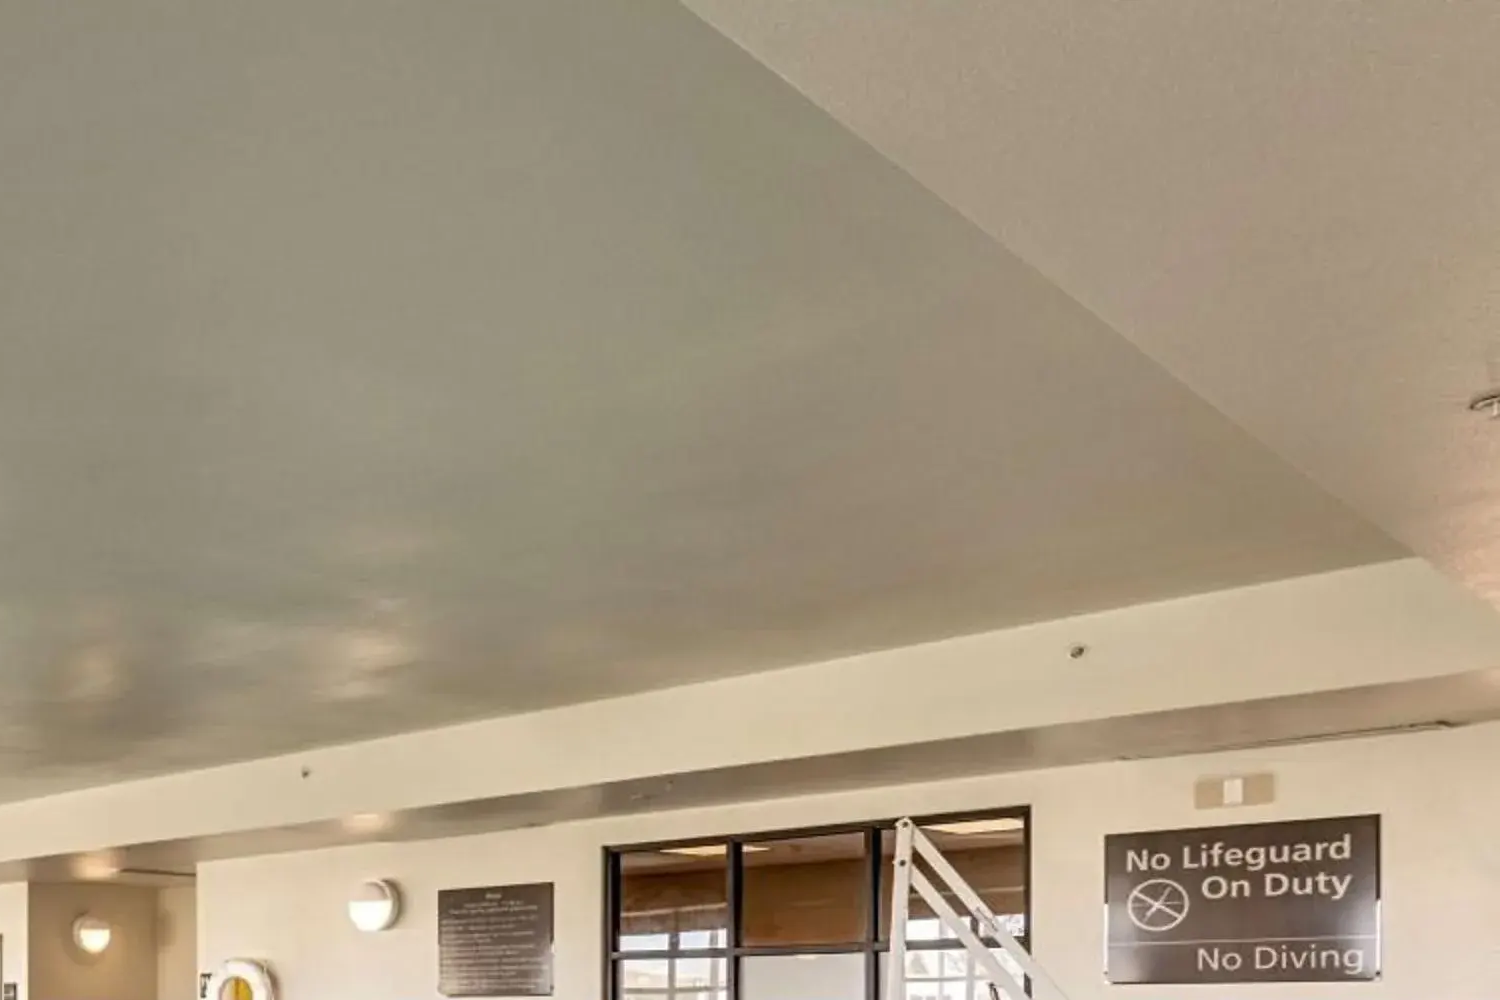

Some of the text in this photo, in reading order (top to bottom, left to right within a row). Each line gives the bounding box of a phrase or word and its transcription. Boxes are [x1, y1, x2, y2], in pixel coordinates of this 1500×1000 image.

[1125, 833, 1352, 872] No Lifeguard
[1201, 870, 1353, 900] On Duty
[1196, 943, 1365, 975] No Diving
